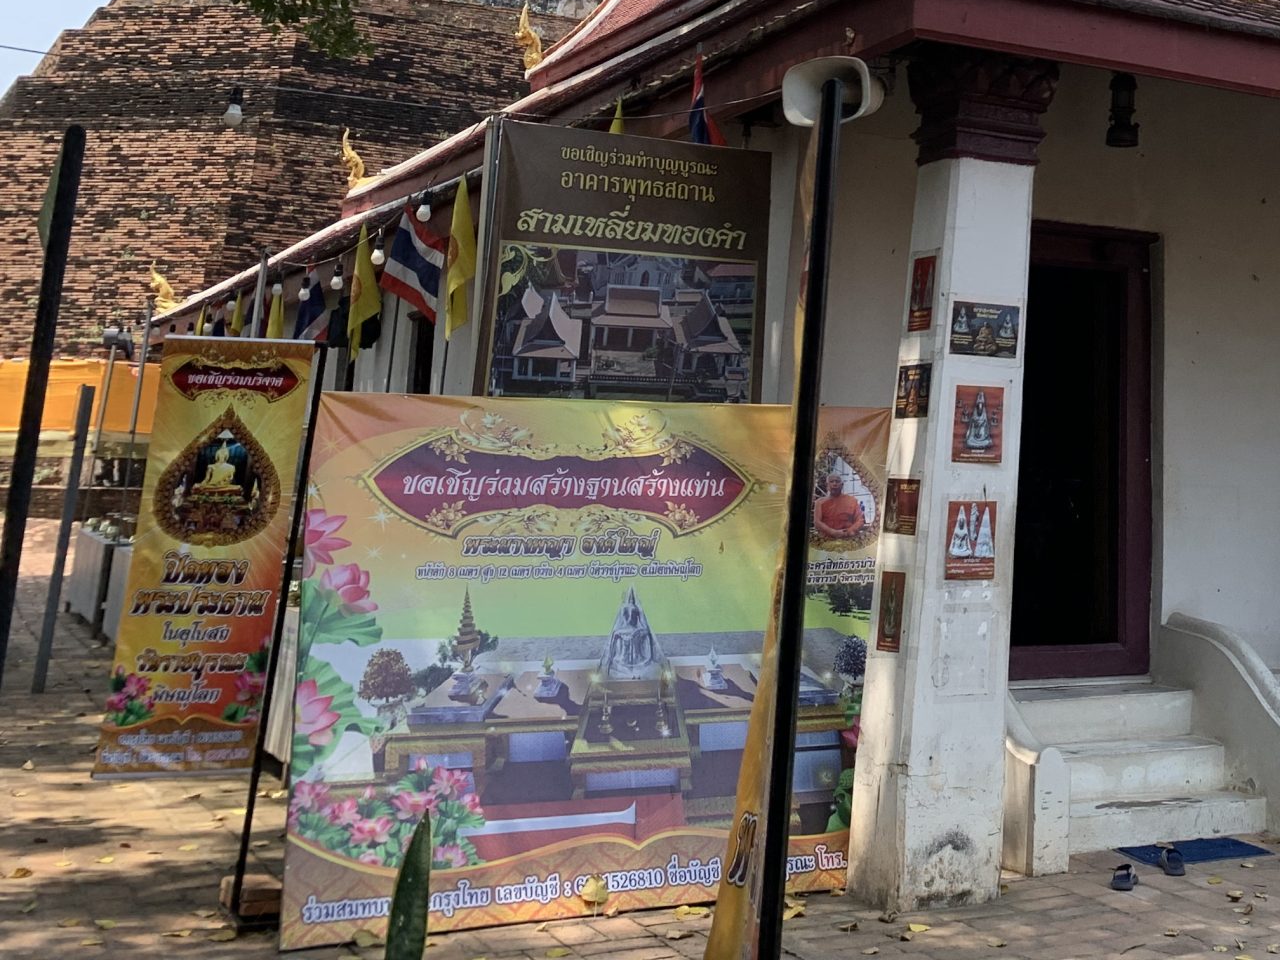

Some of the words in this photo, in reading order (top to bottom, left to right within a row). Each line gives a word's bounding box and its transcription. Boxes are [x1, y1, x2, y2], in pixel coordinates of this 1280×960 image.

[560, 145, 718, 178] ขอเชิญร่วมทำบุญบูรณะ
[560, 171, 716, 202] อาคารพุทธสถาน
[516, 205, 747, 250] สามเหลี่ยมทองคำ
[402, 467, 726, 502] ขอเชิญร่วมสร้างฐานสร้างแท่น
[162, 550, 249, 585] ปิดทอง
[129, 587, 271, 616] พระประธาน
[496, 874, 560, 902] เลขบัญชี
[575, 868, 664, 895] 61526810
